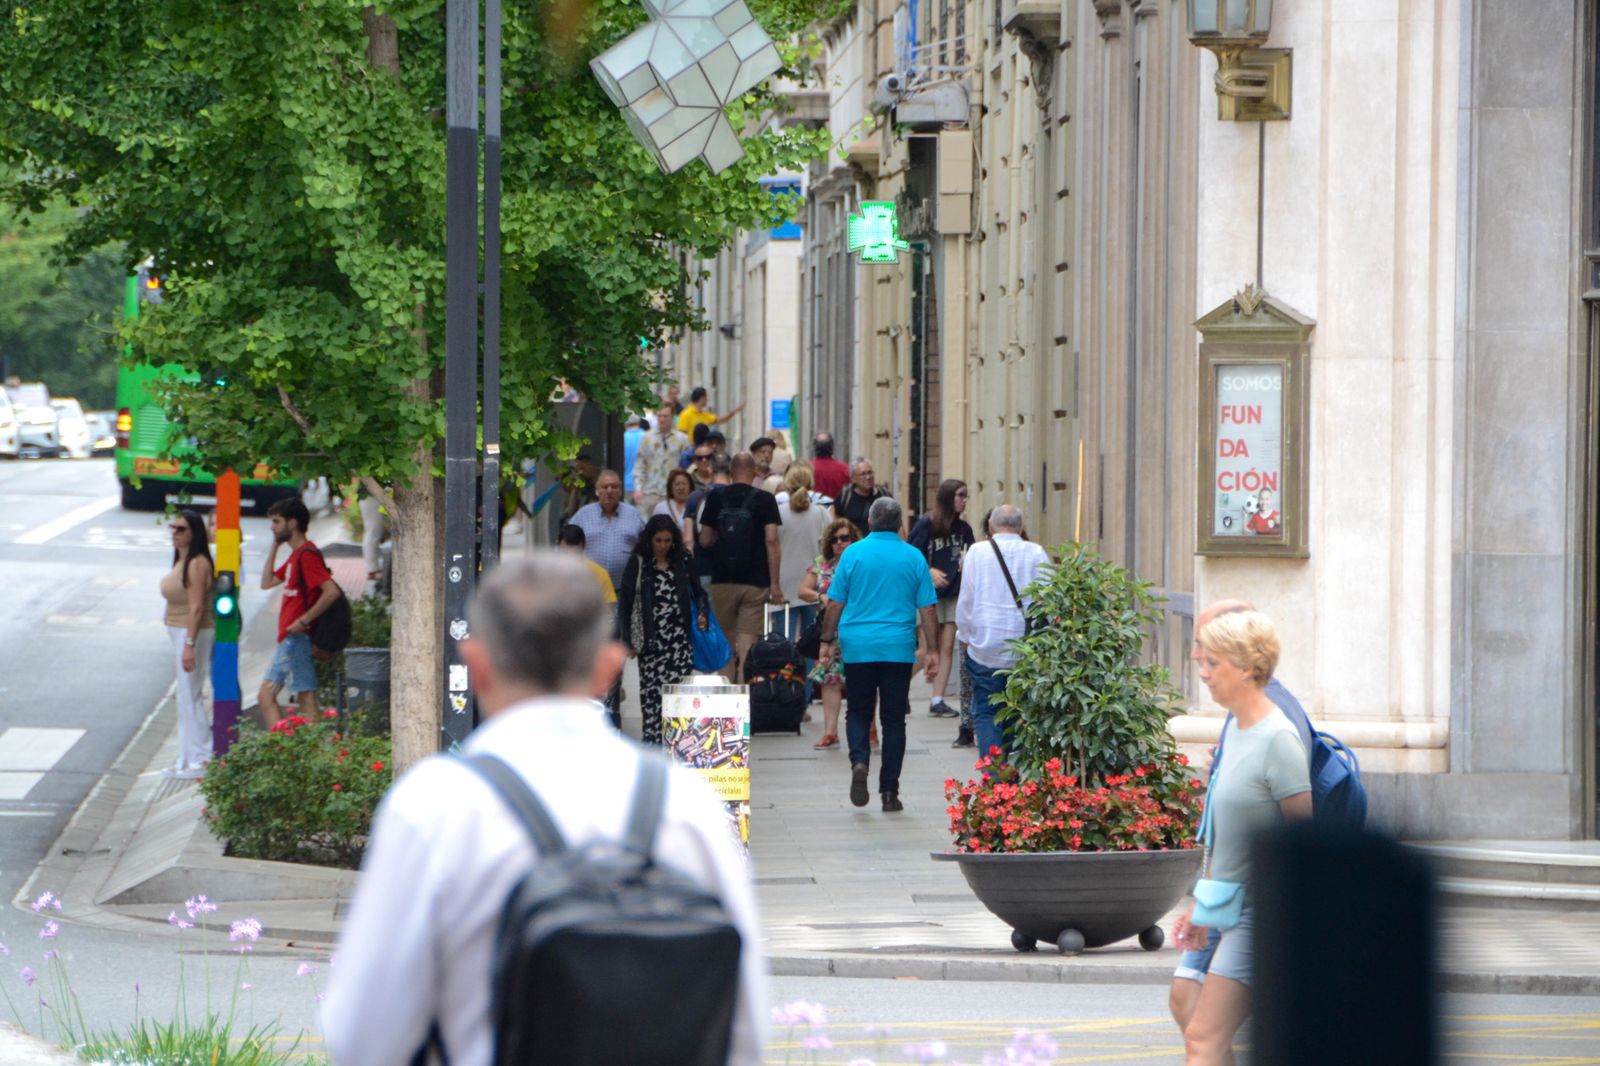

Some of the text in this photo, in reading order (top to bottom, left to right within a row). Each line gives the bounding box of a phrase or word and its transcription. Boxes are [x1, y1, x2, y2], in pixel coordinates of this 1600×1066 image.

[1222, 376, 1282, 391] SOMOS
[1220, 405, 1262, 425] FUN
[1219, 438, 1249, 458] DA
[1217, 467, 1278, 492] CIÓN
